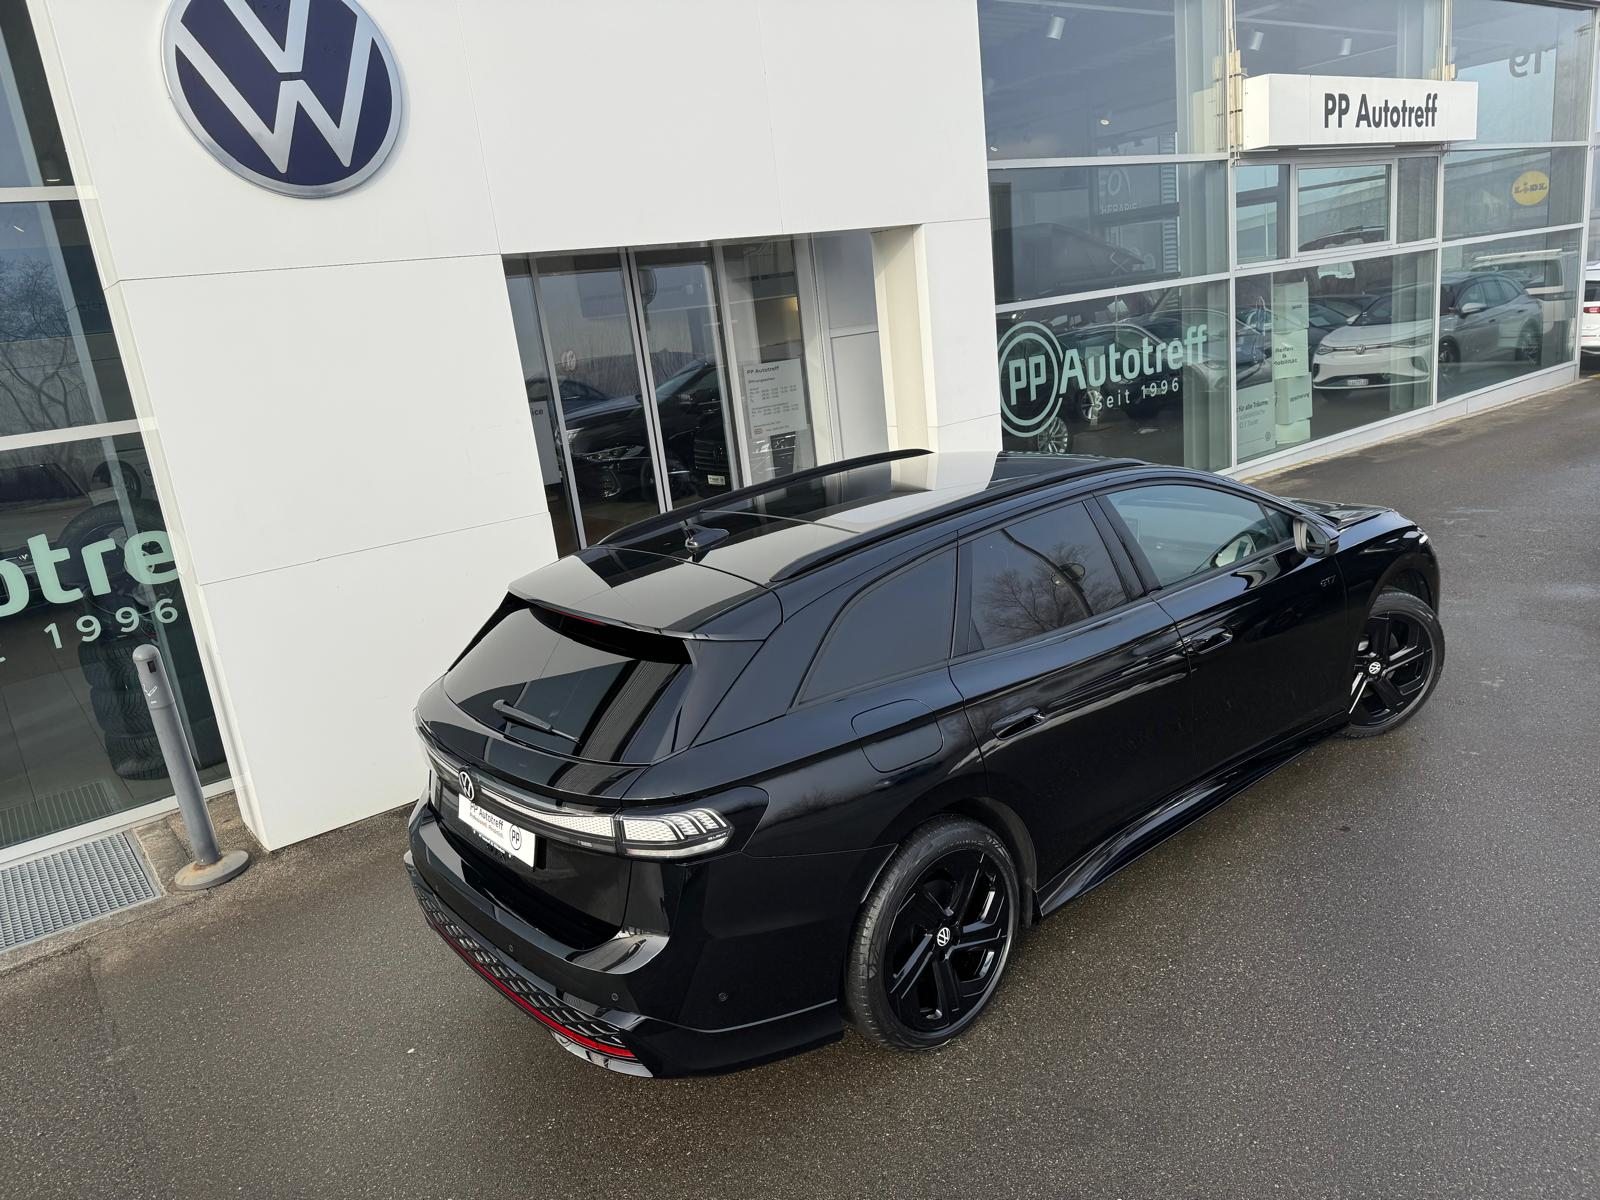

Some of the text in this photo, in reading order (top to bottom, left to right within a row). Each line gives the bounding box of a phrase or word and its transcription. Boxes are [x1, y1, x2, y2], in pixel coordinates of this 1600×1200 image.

[1324, 92, 1438, 129] PP Autotreff
[1009, 323, 1208, 406] PP Autotreff
[1141, 377, 1179, 399] 1996
[43, 598, 179, 650] 1996
[479, 808, 504, 831] Autotreff
